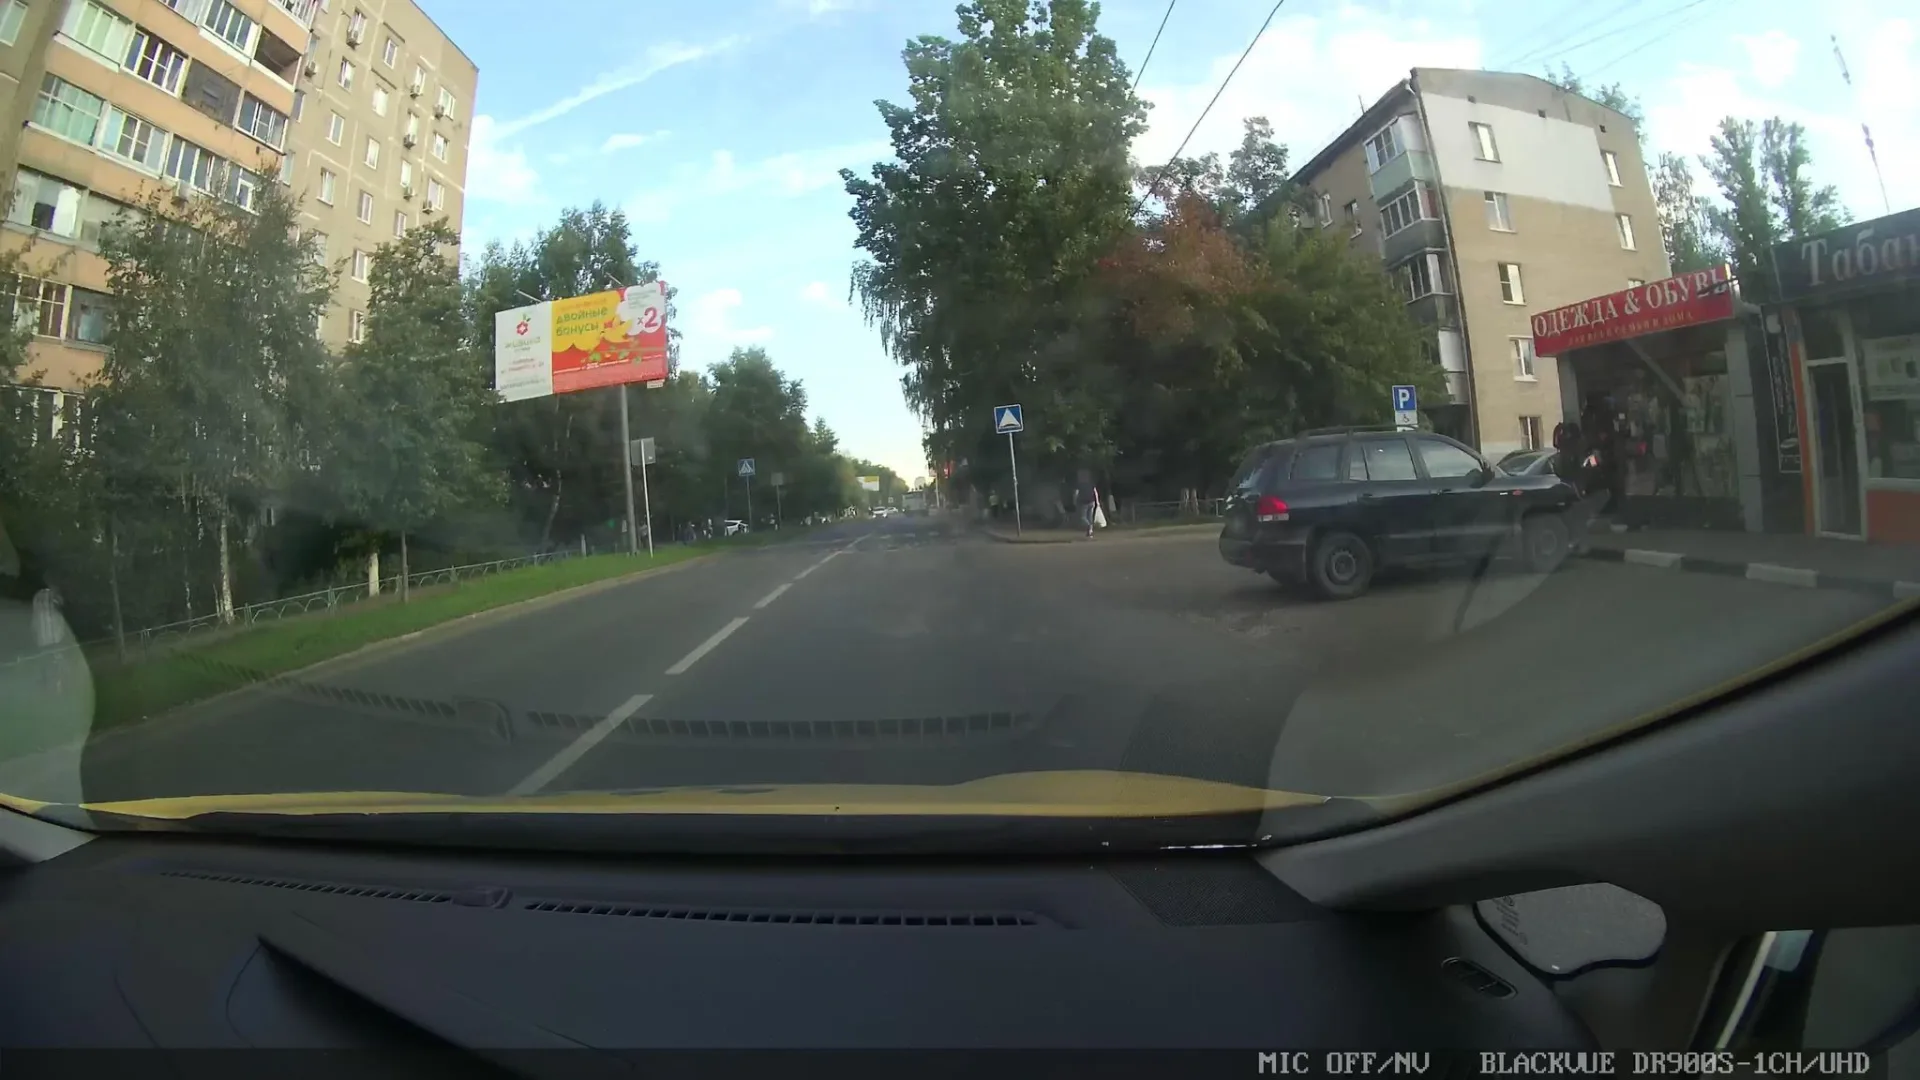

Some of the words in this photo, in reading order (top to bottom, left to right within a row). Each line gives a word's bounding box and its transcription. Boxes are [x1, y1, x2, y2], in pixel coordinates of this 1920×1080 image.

[1533, 298, 1619, 338] ОДЕЖДА
[1624, 290, 1641, 315] &
[1645, 268, 1728, 309] ОБУВЬ
[1398, 389, 1410, 409] P
